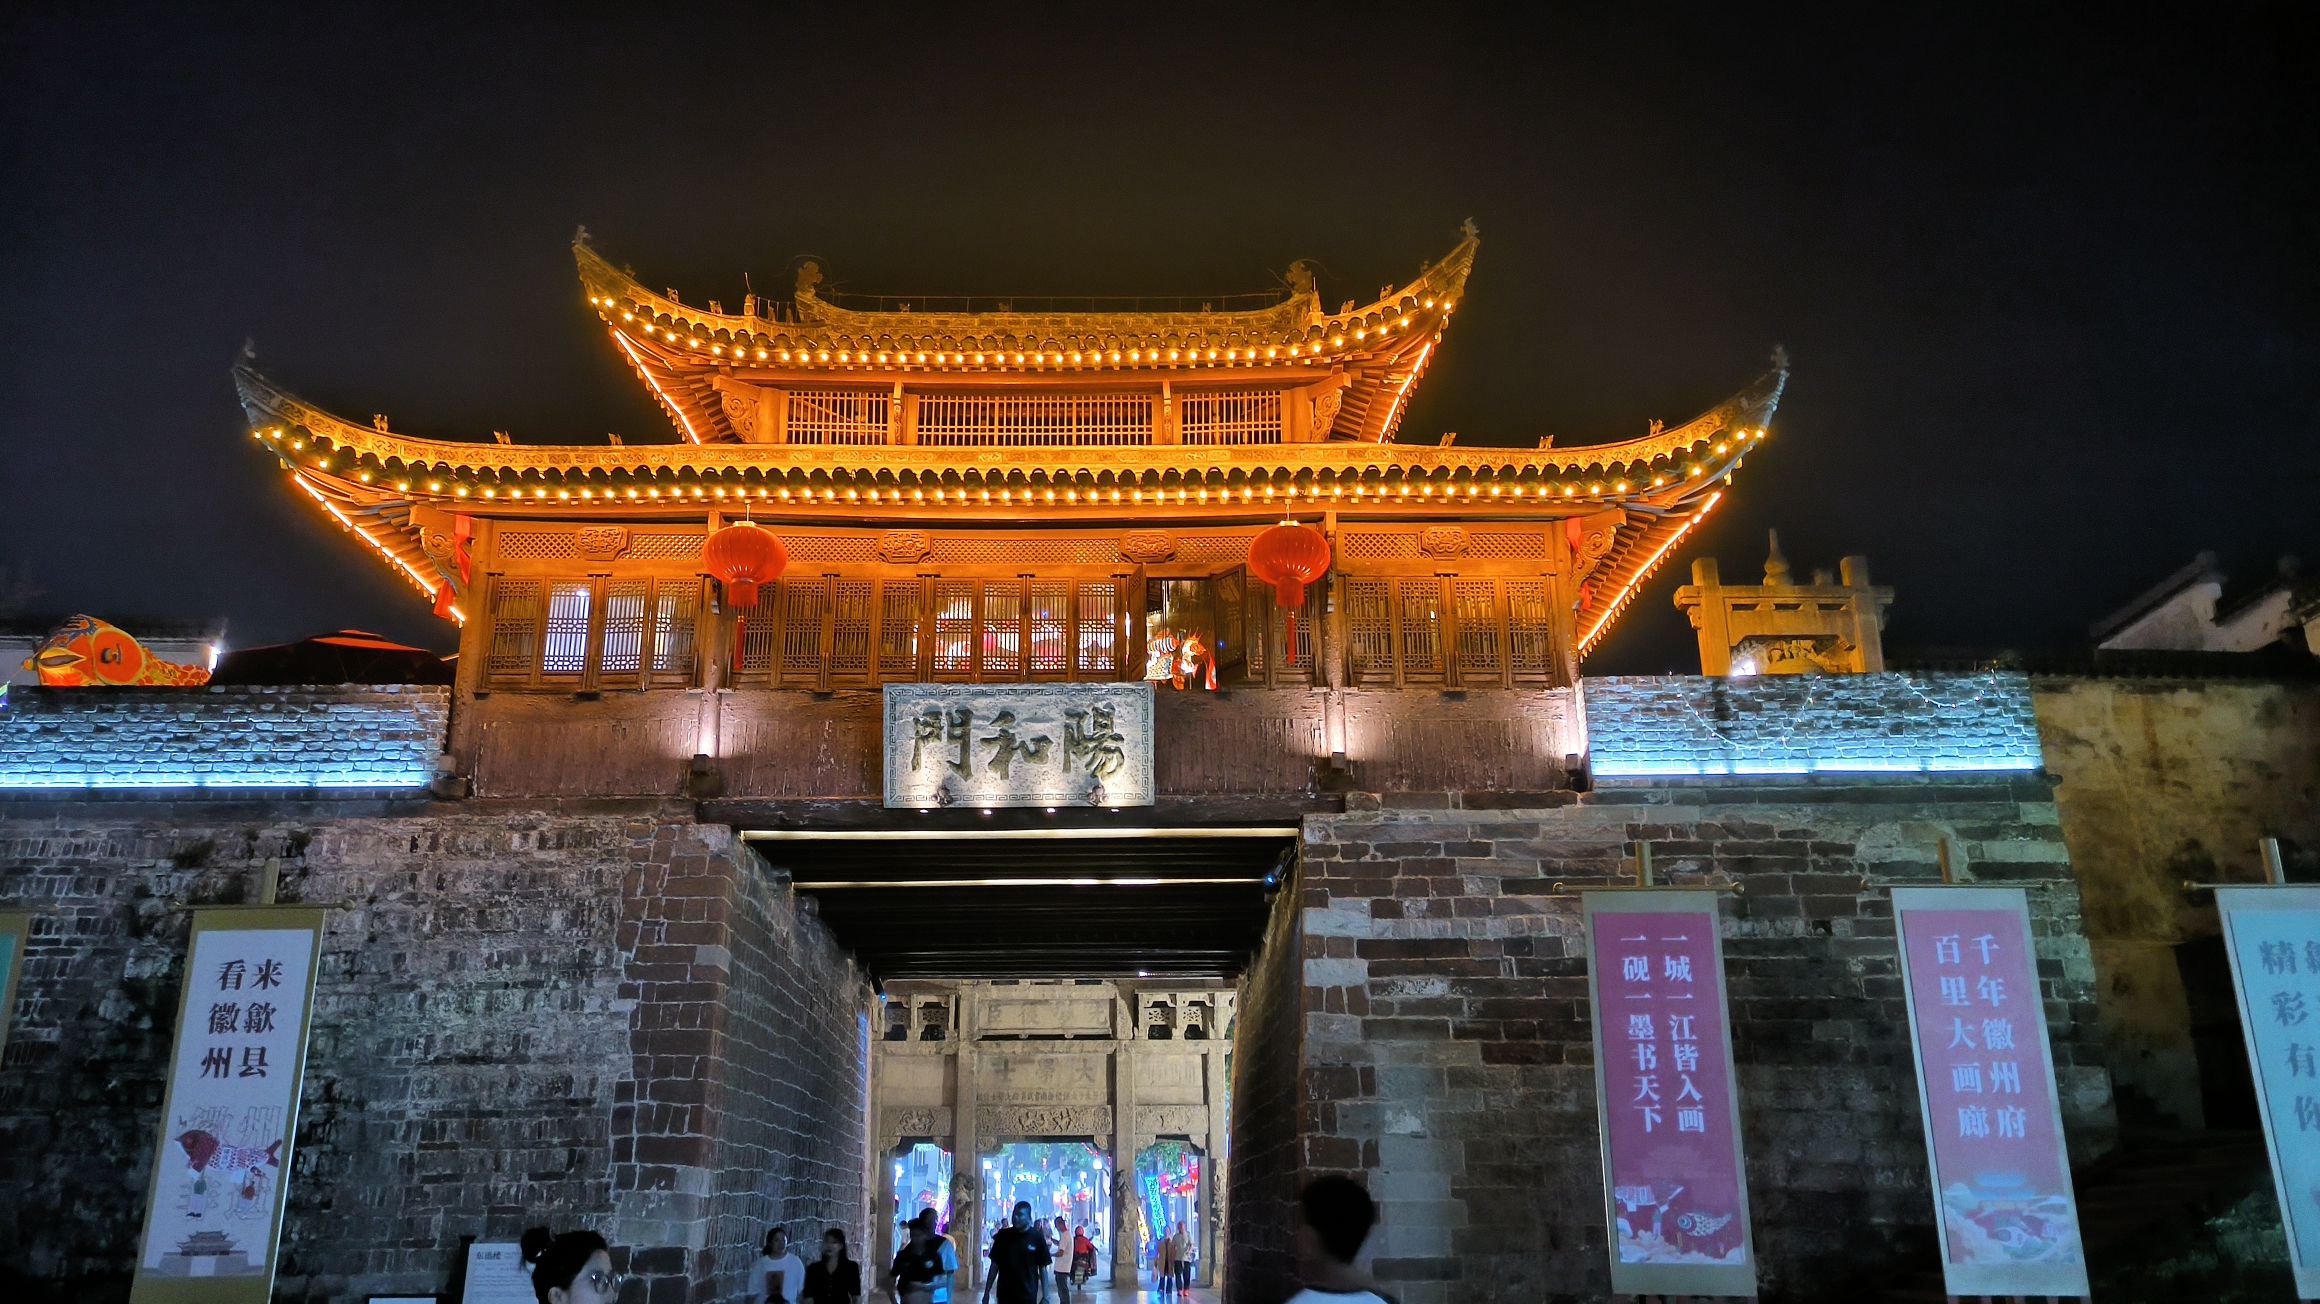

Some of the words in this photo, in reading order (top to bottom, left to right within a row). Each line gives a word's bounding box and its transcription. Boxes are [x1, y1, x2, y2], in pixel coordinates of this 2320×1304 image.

[199, 959, 249, 1080] 看徽州
[237, 958, 283, 1079] 来歙县
[1619, 933, 1663, 1134] 一砚一墨书天下
[1661, 933, 1706, 1134] 一城一江皆入画
[1932, 934, 1990, 1139] 百里大画廊
[1969, 933, 2027, 1139] 千年徽州府
